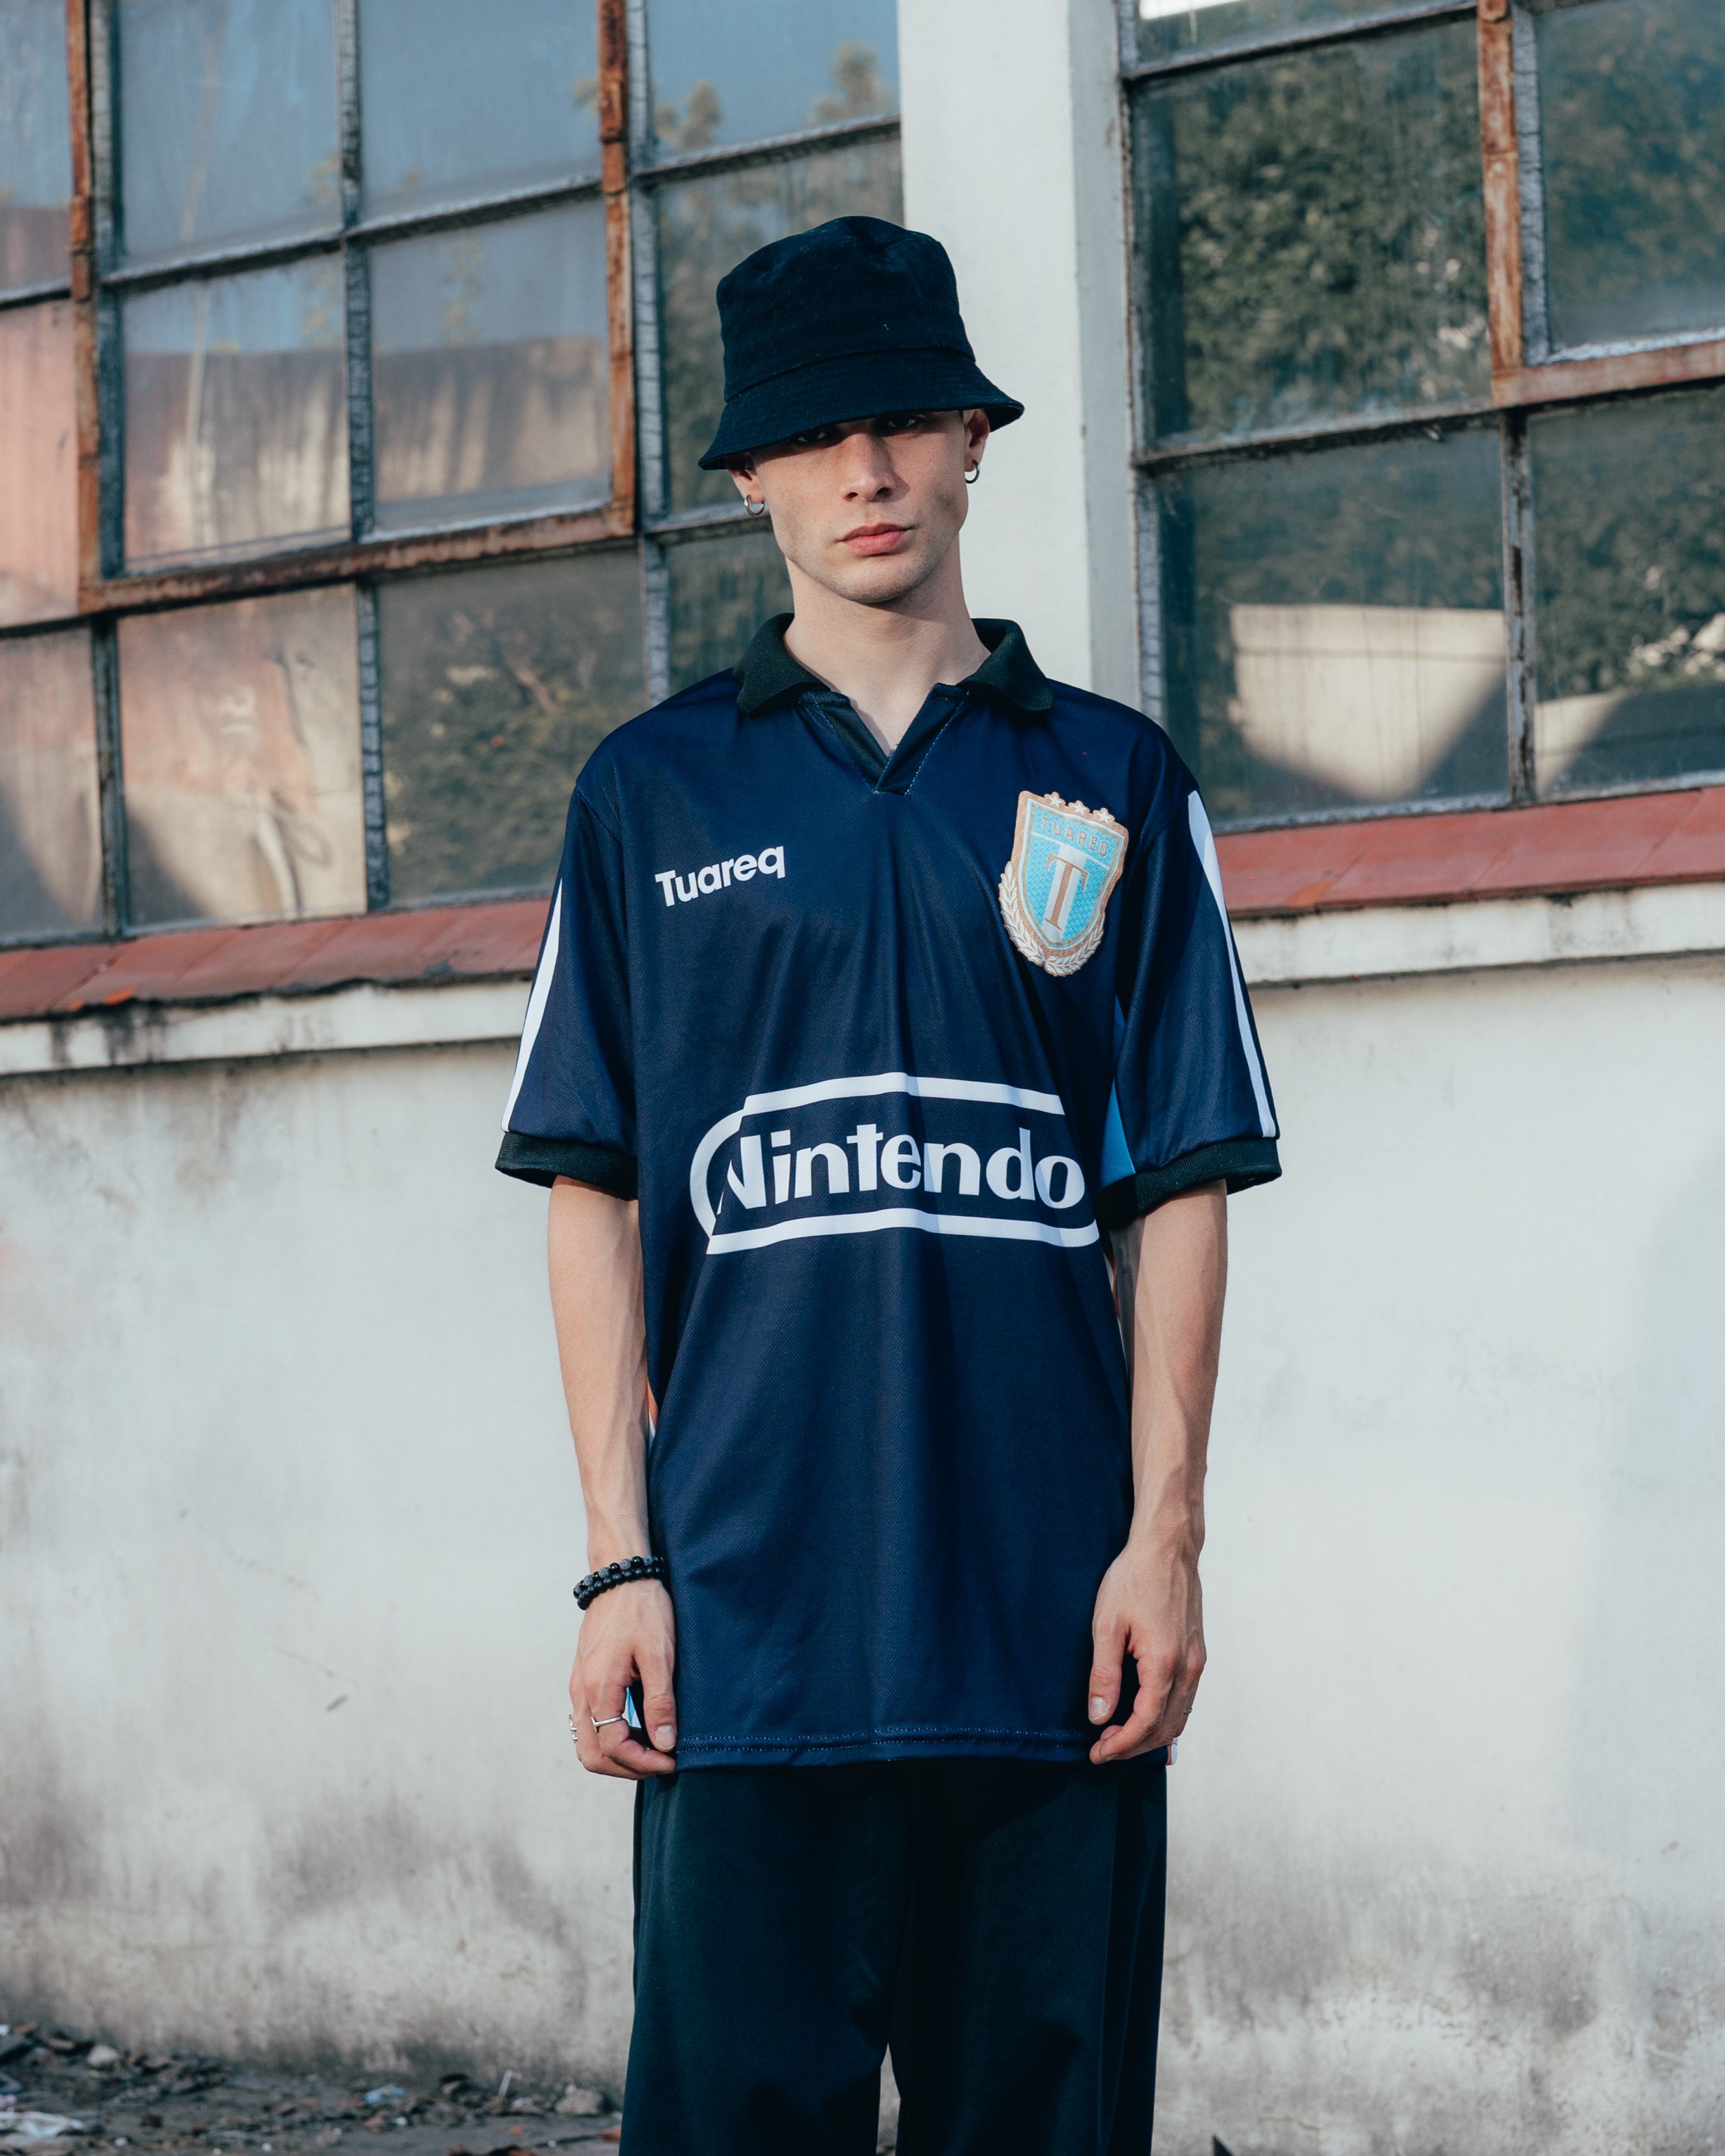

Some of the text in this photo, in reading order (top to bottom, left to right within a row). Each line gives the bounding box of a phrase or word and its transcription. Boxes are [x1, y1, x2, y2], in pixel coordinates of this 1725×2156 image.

[655, 846, 786, 907] Tuareq
[1044, 853, 1089, 931] T
[717, 1123, 1085, 1213] Nintendo
